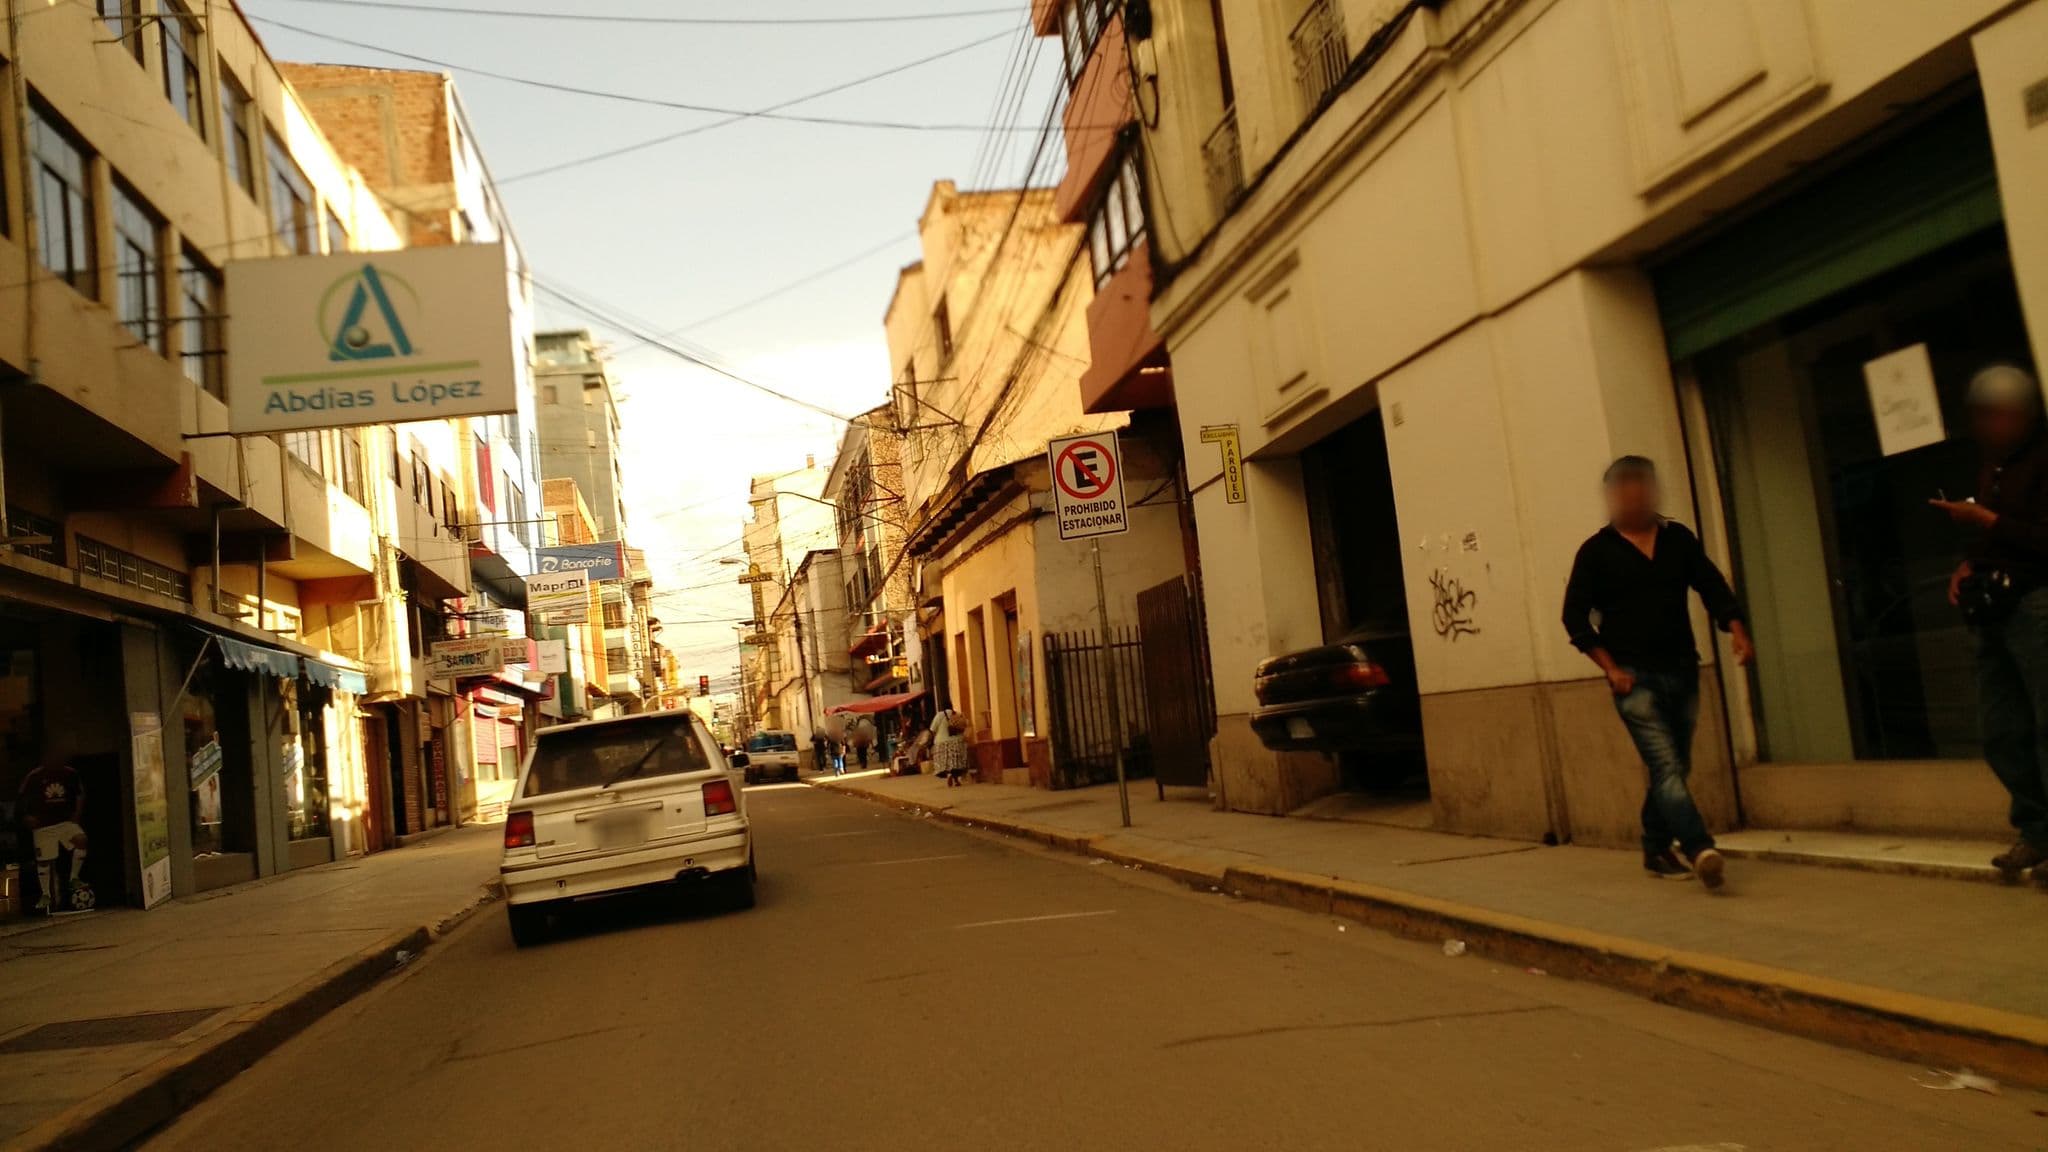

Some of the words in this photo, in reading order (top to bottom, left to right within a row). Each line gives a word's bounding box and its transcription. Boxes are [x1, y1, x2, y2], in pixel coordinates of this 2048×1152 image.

[264, 387, 375, 415] Abdias
[391, 379, 483, 405] López
[1226, 440, 1240, 500] PARQUEO
[1063, 499, 1116, 517] PROHIBIDO
[1062, 513, 1122, 531] ESTACIONAR
